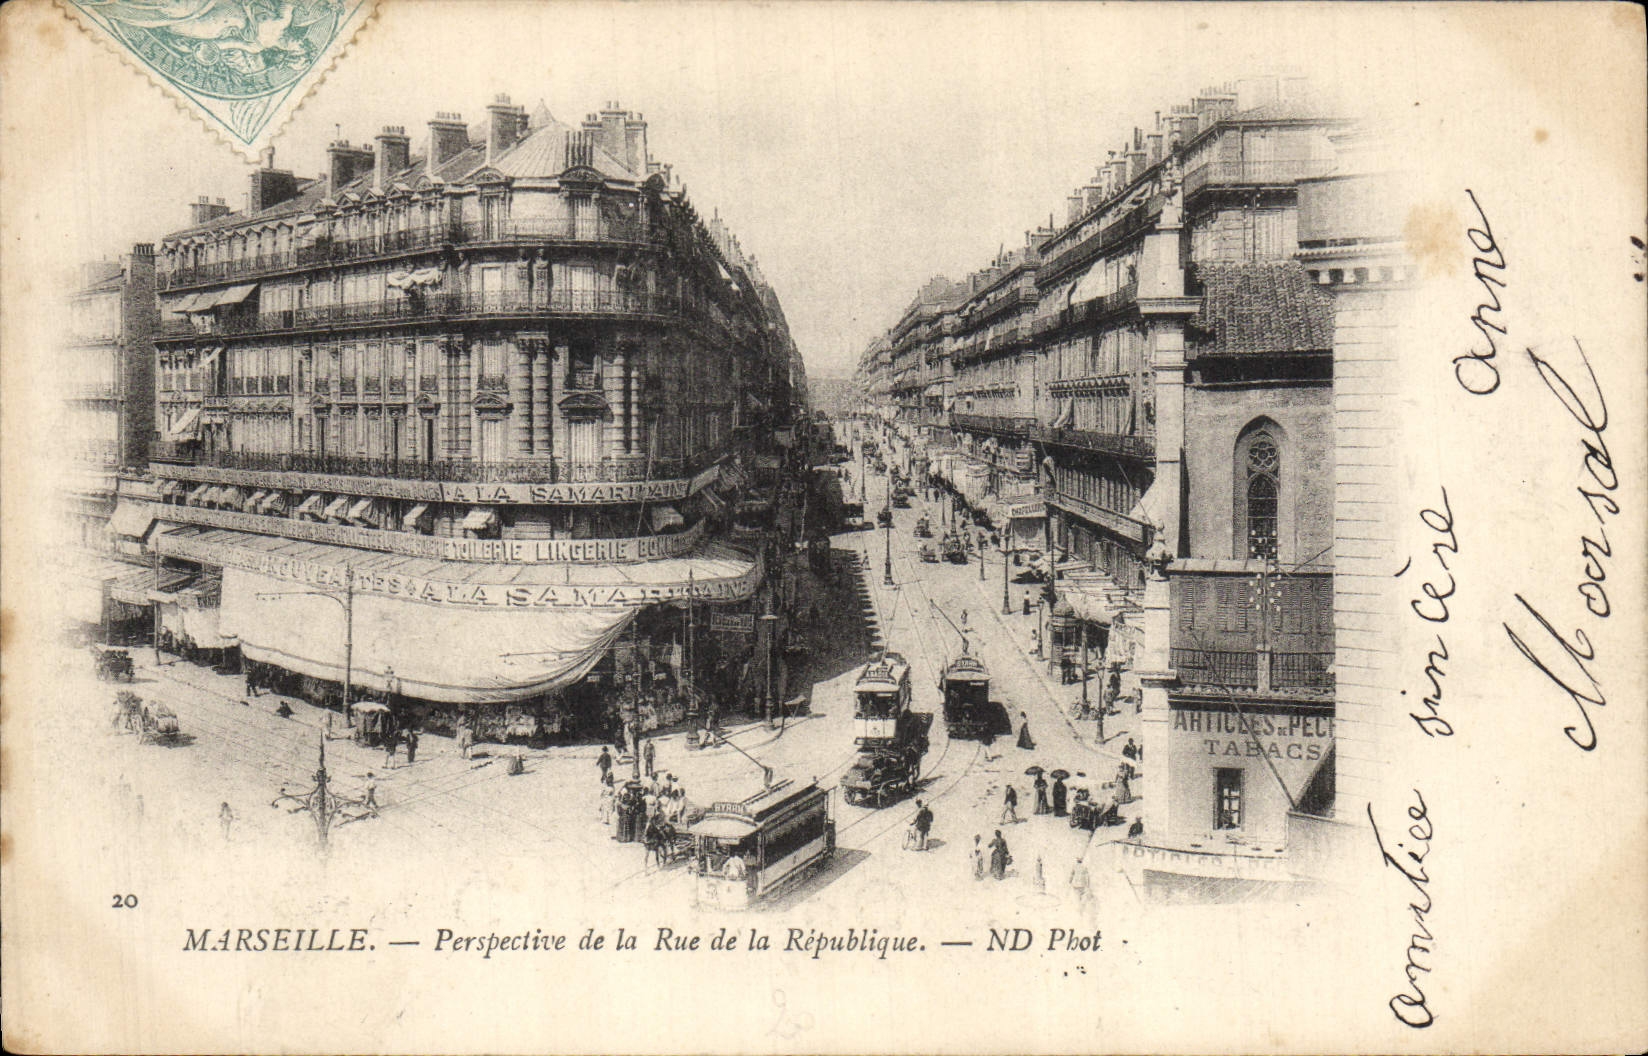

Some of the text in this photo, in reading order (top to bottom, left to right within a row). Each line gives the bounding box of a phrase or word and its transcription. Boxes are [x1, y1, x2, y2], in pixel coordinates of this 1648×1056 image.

[475, 485, 519, 503] LA
[1174, 711, 1275, 736] ARTICLES
[1204, 739, 1321, 761] TABACS
